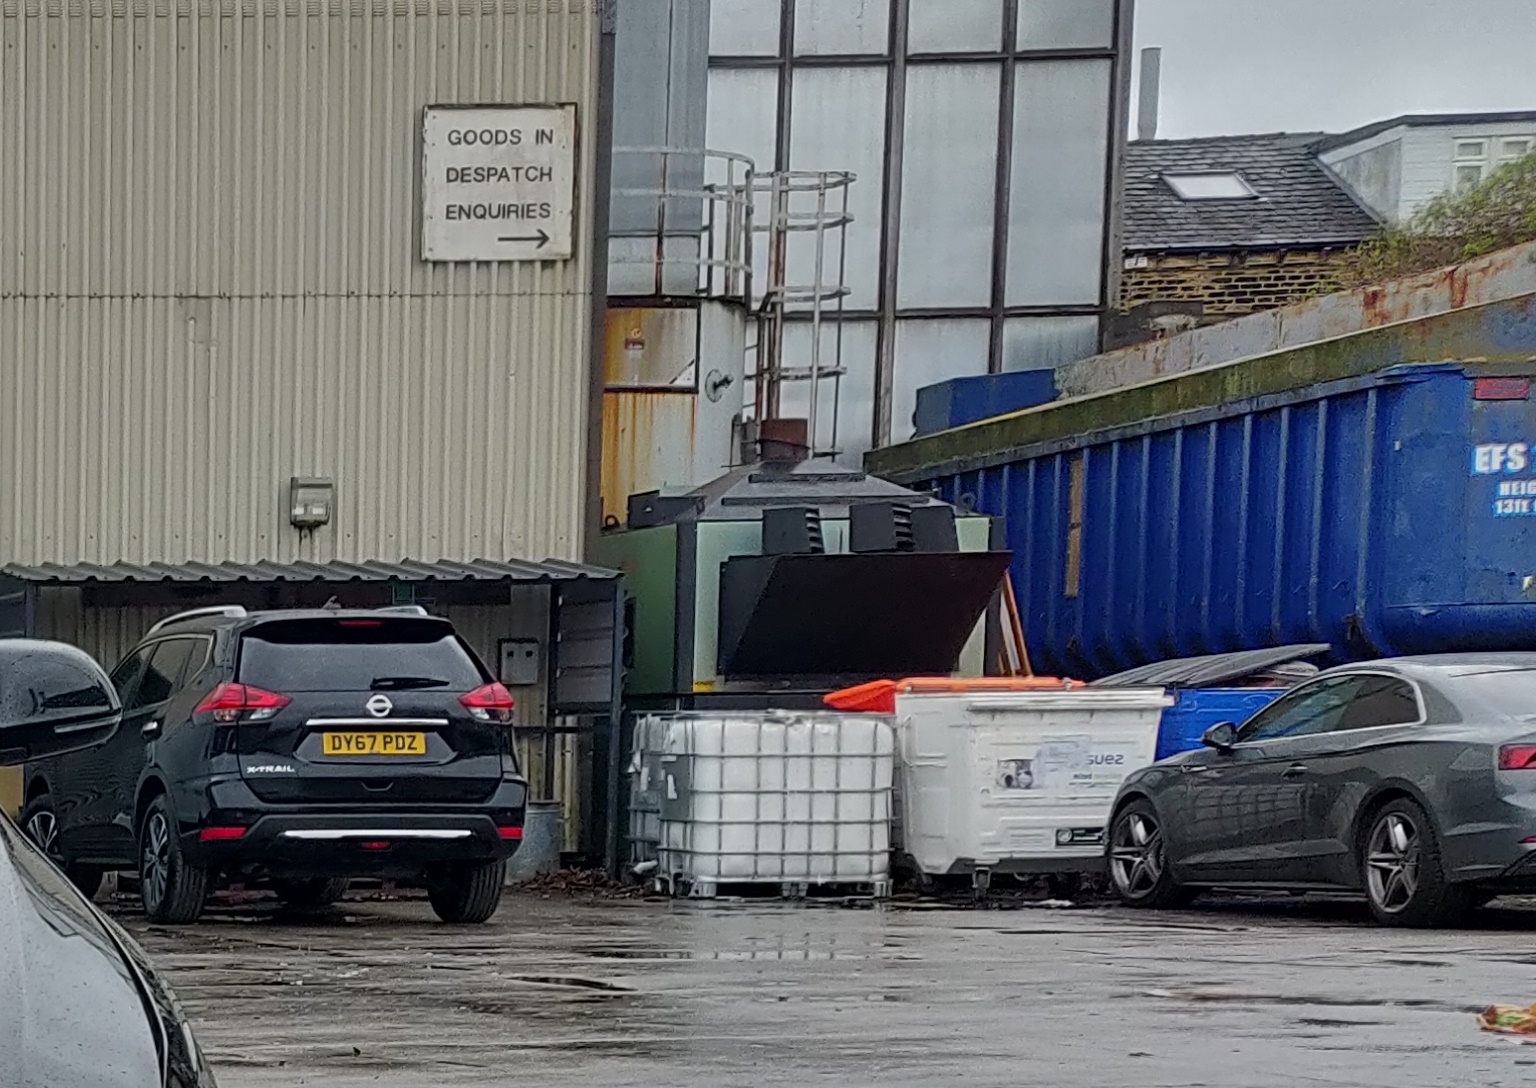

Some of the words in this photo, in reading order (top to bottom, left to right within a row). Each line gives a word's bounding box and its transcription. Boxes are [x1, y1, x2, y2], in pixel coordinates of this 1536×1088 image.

[447, 129, 522, 146] GOODS
[535, 129, 554, 145] IN
[446, 166, 553, 183] DESPATCH
[445, 203, 551, 220] ENQUIRIES
[1473, 442, 1527, 473] EFS
[331, 735, 377, 751] DY67
[383, 735, 418, 751] PDZ
